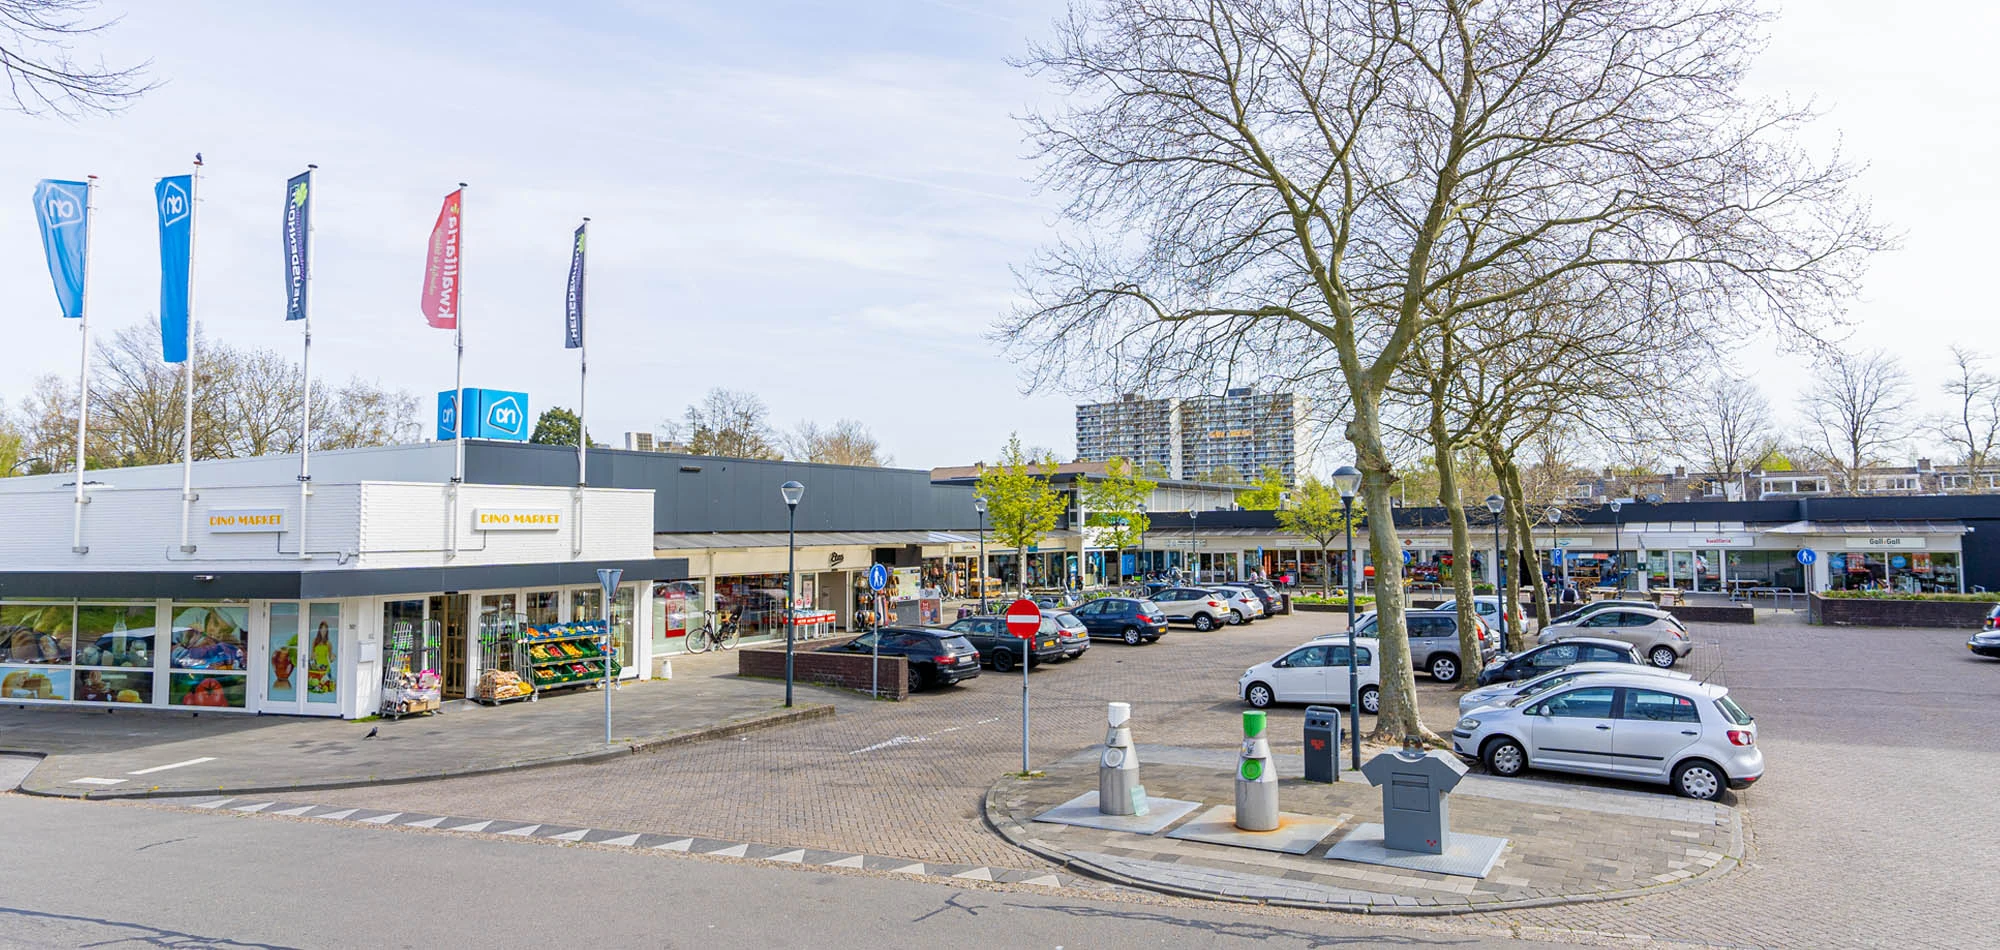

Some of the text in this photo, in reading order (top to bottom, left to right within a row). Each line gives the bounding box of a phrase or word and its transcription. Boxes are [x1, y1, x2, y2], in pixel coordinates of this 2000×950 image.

[210, 514, 281, 526] DINO MARKET
[481, 514, 560, 524] DINO MARKET
